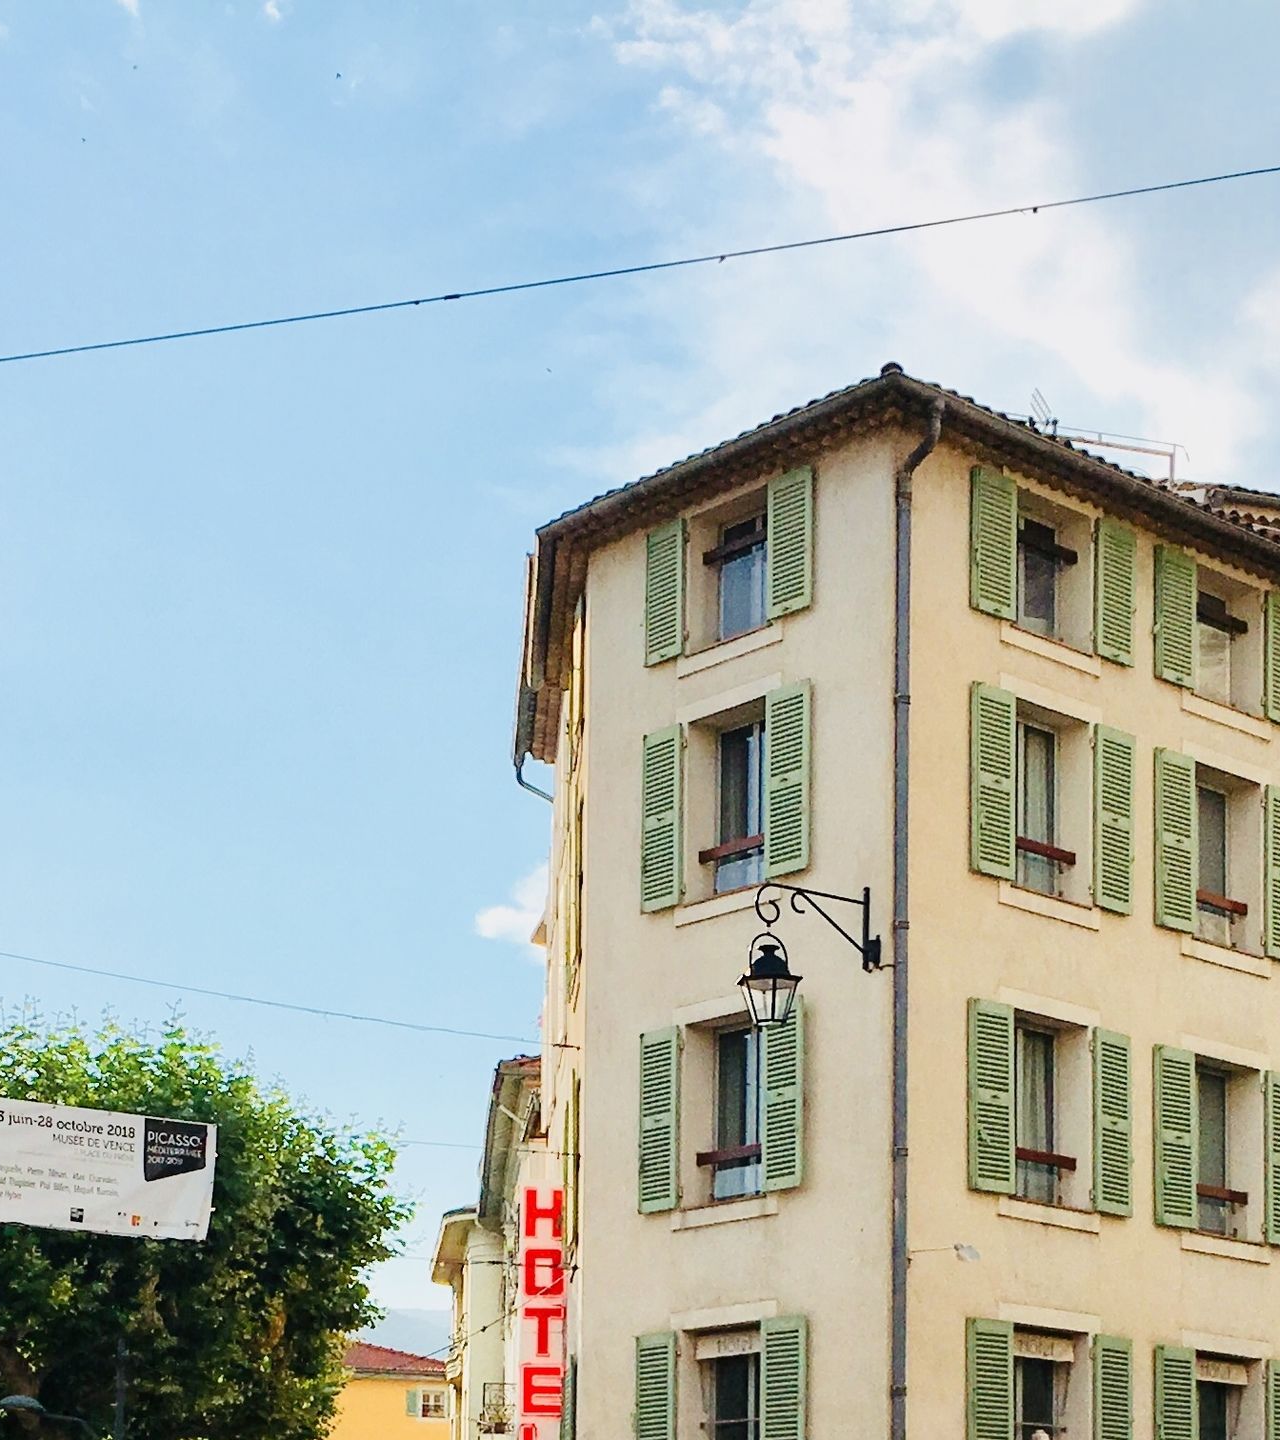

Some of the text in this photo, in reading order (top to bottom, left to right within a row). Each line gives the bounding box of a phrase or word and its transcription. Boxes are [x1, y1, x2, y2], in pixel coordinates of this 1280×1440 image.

[8, 1114, 53, 1128] juin-28
[56, 1120, 104, 1134] octobre
[107, 1125, 136, 1139] 2018
[87, 1138, 100, 1149] DE
[102, 1140, 135, 1153] VENCE
